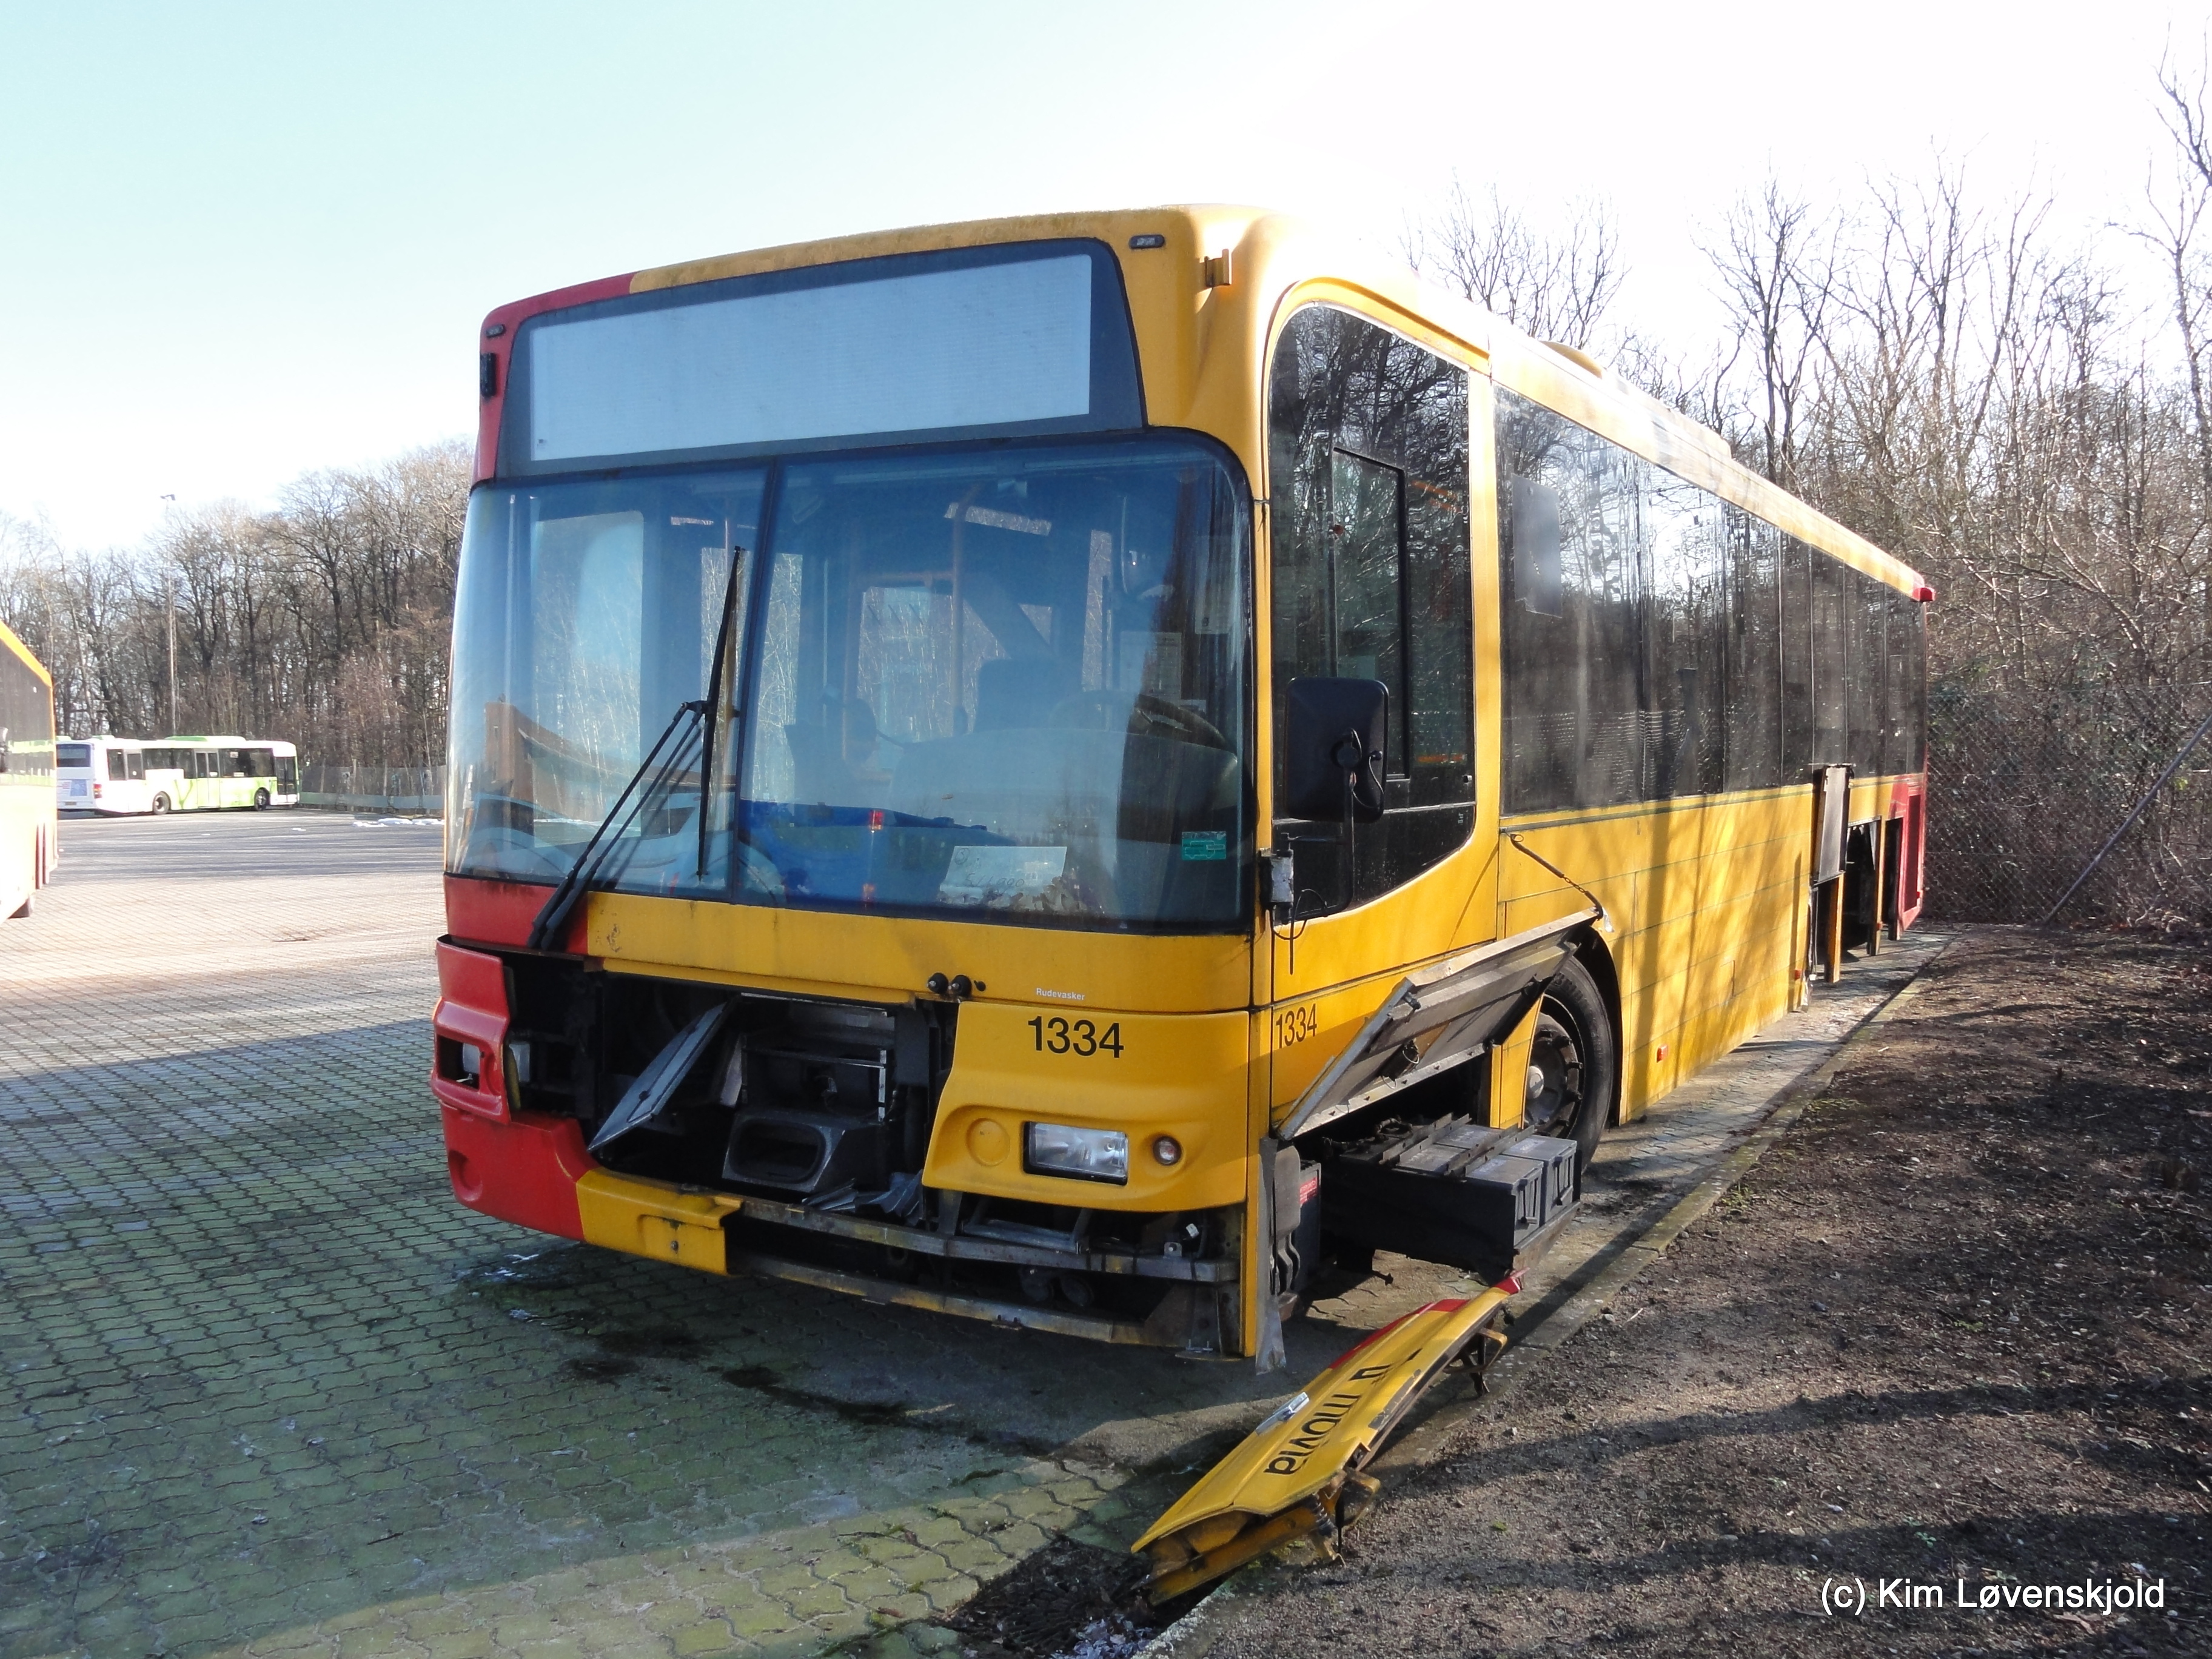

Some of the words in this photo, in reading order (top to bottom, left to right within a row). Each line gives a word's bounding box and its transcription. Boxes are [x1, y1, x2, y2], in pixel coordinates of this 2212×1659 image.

[1036, 988, 1085, 1000] Rudevasker
[1028, 1016, 1124, 1058] 1334
[1276, 1003, 1317, 1048] 1334
